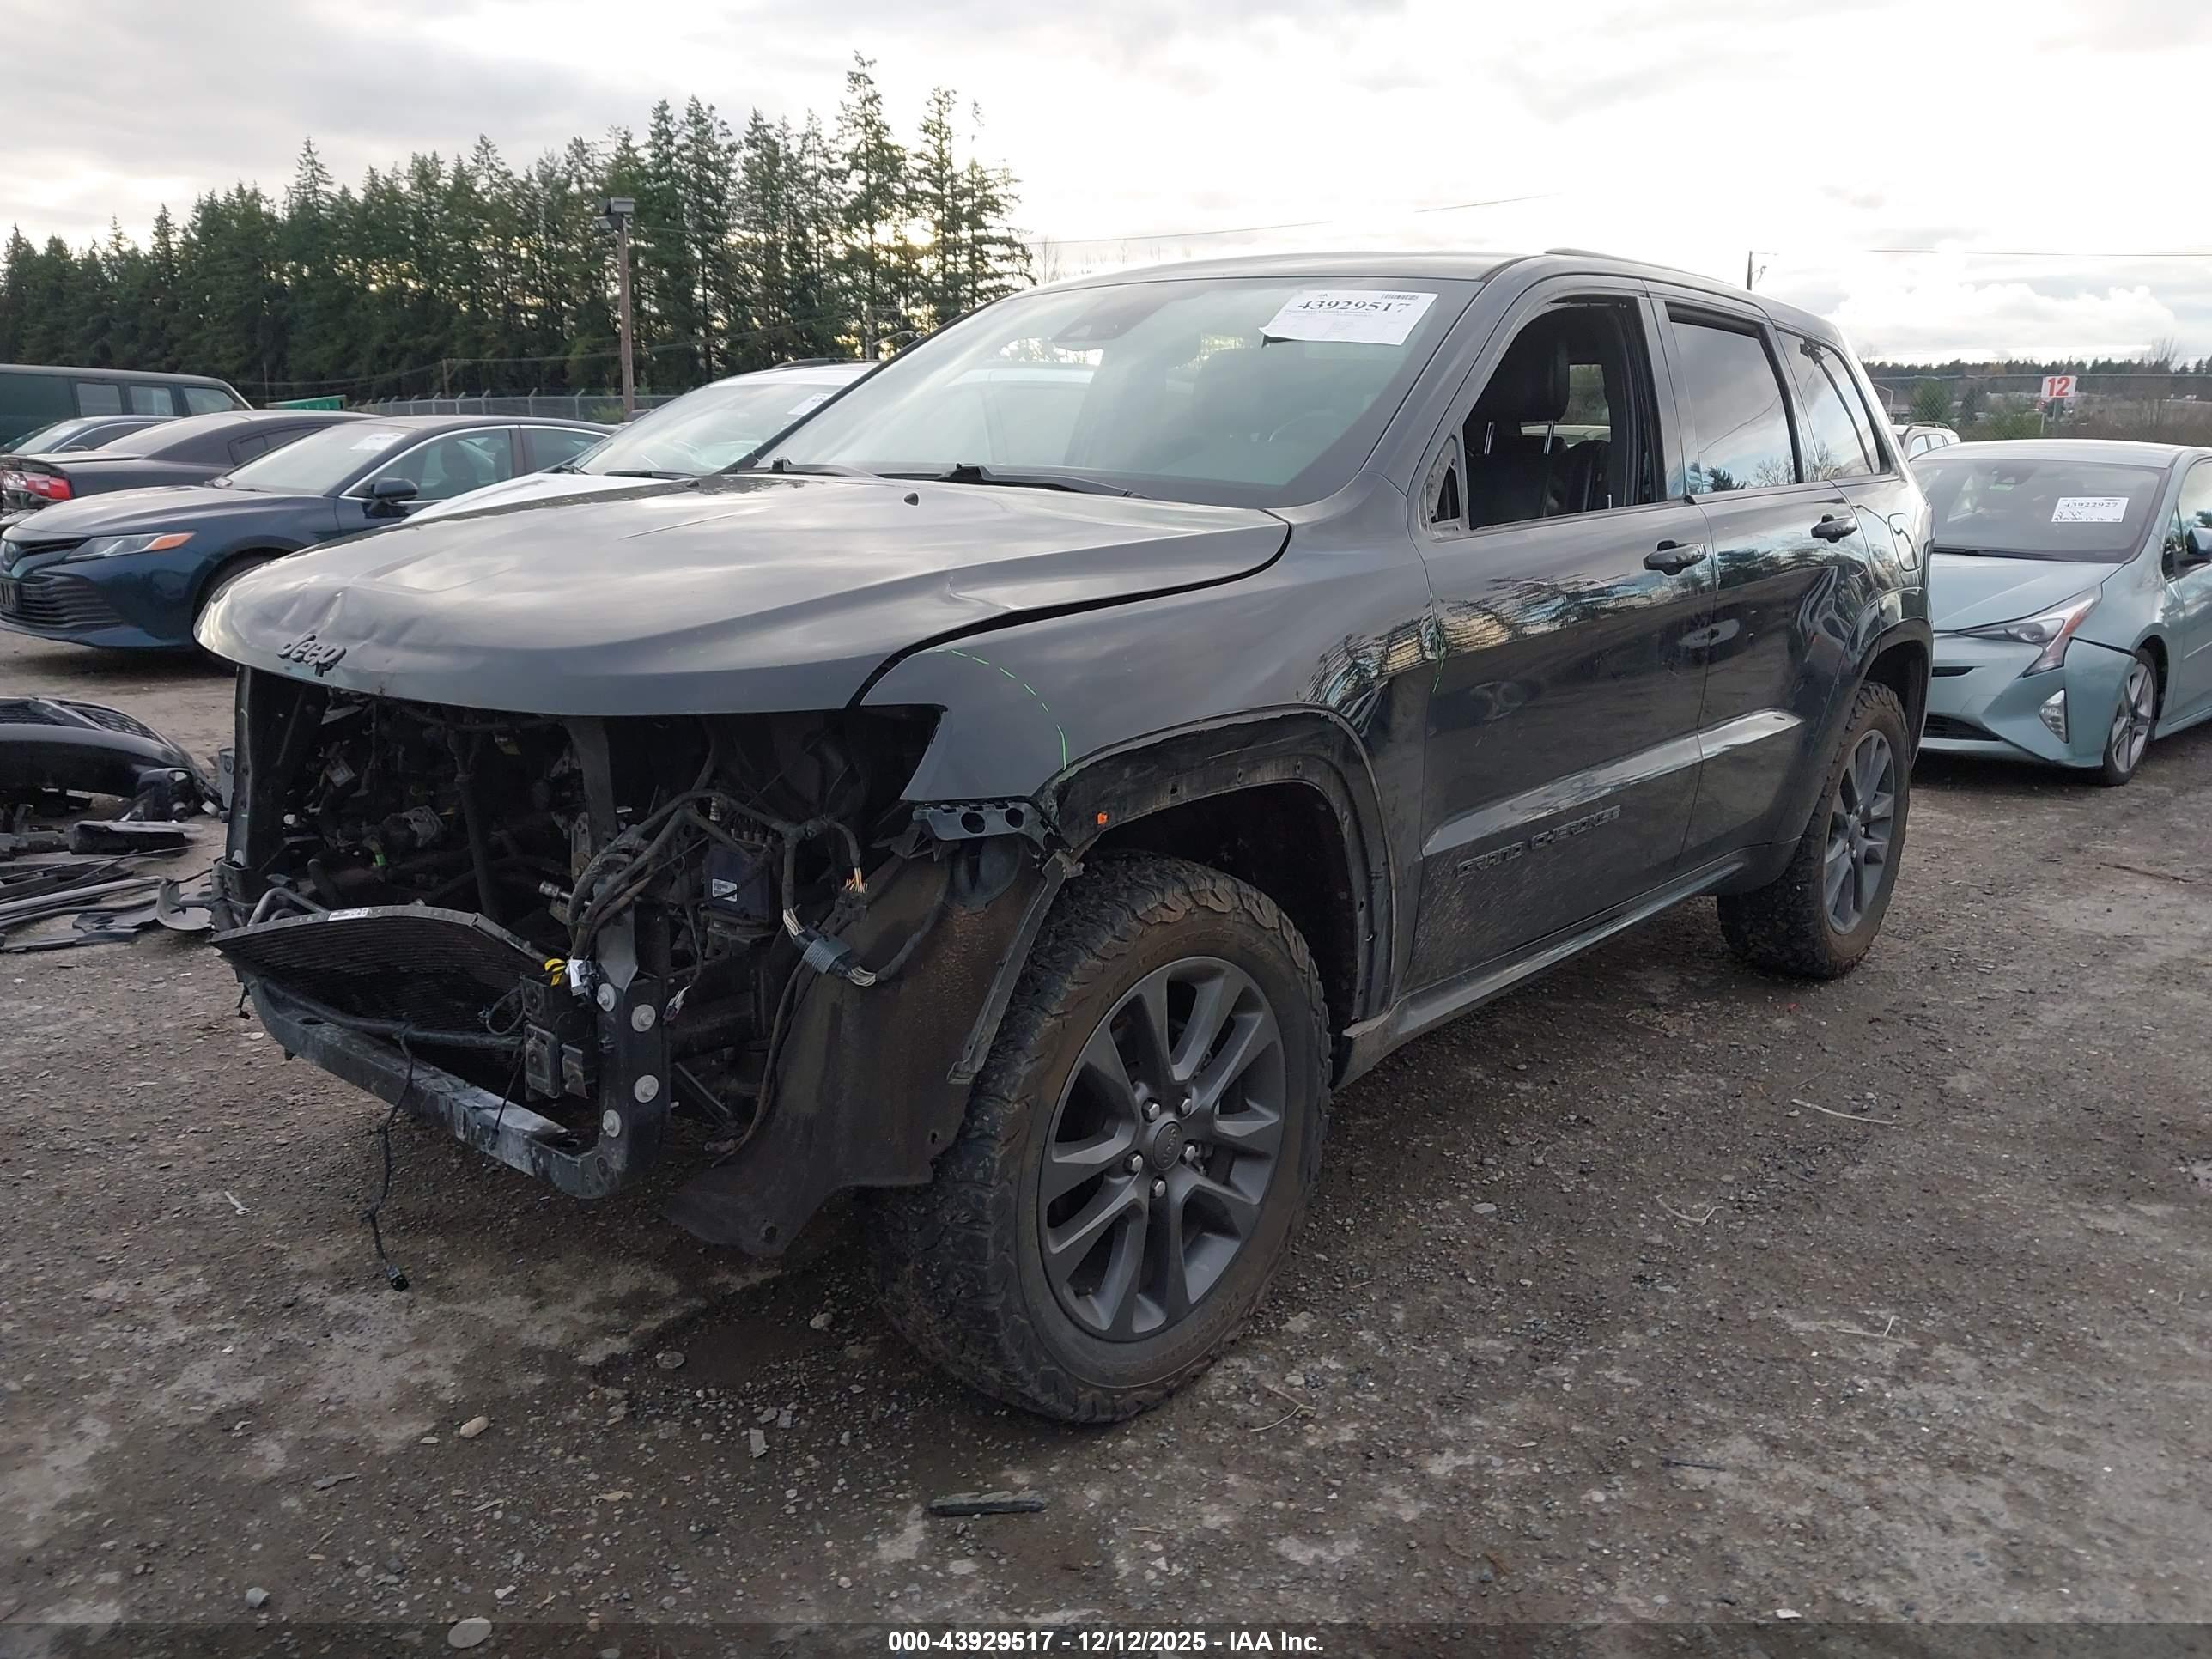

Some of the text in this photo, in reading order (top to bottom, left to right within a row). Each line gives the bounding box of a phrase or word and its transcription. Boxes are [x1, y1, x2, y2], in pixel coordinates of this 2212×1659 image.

[1297, 300, 1412, 313] 43929517
[2047, 376, 2071, 397] 12
[276, 635, 347, 677] Jeep
